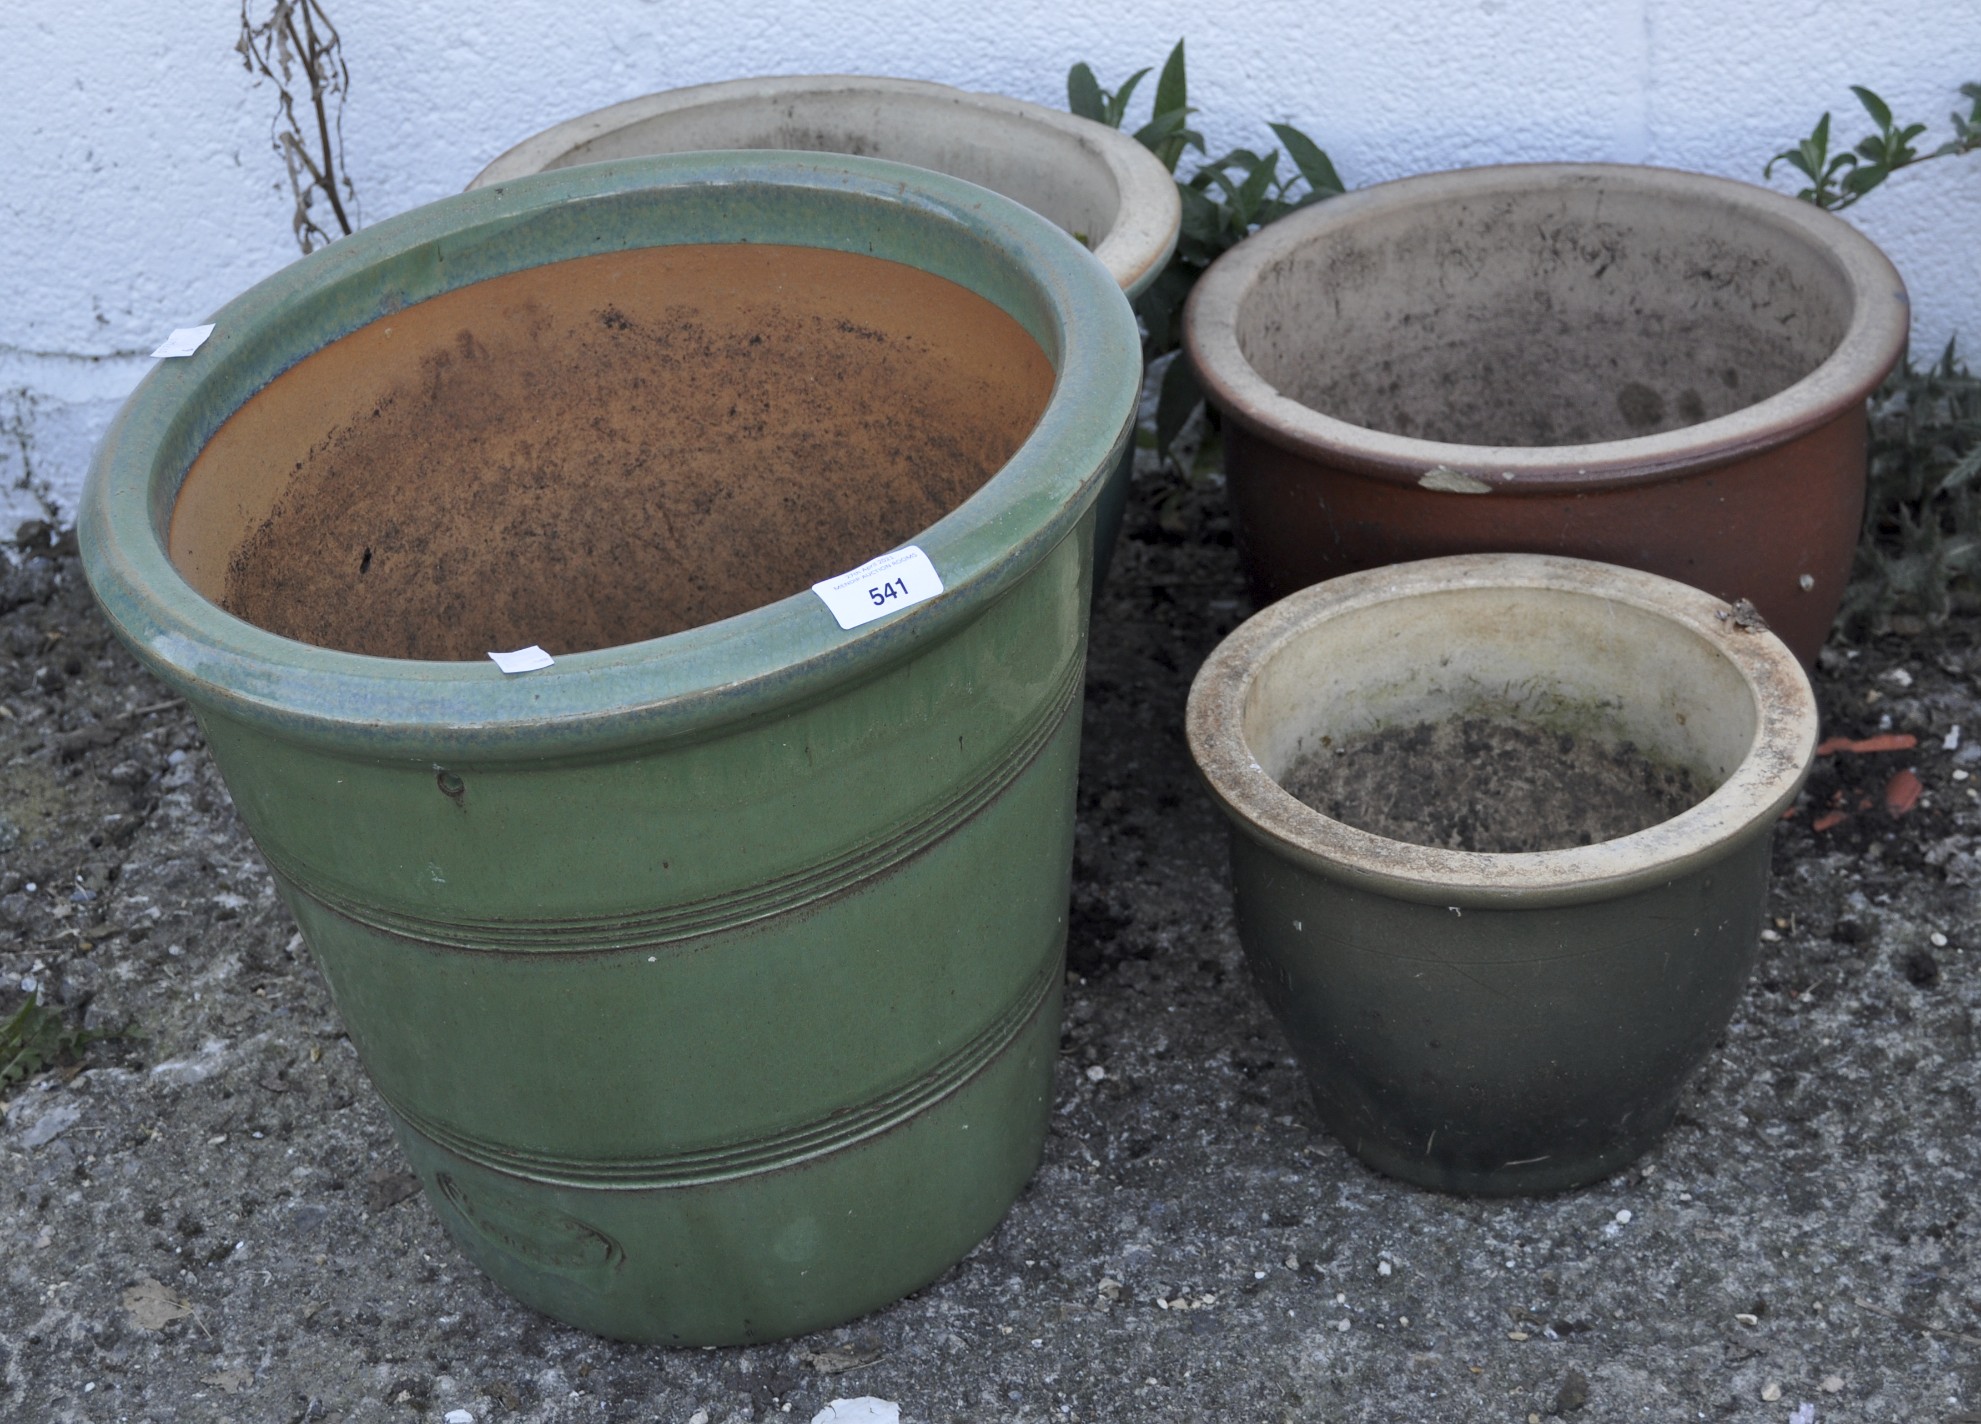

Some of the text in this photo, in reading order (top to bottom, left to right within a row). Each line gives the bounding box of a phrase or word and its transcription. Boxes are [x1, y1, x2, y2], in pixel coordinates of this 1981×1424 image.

[862, 564, 891, 579] AUCTION
[892, 552, 918, 566] ROOMS
[868, 577, 909, 606] 541
